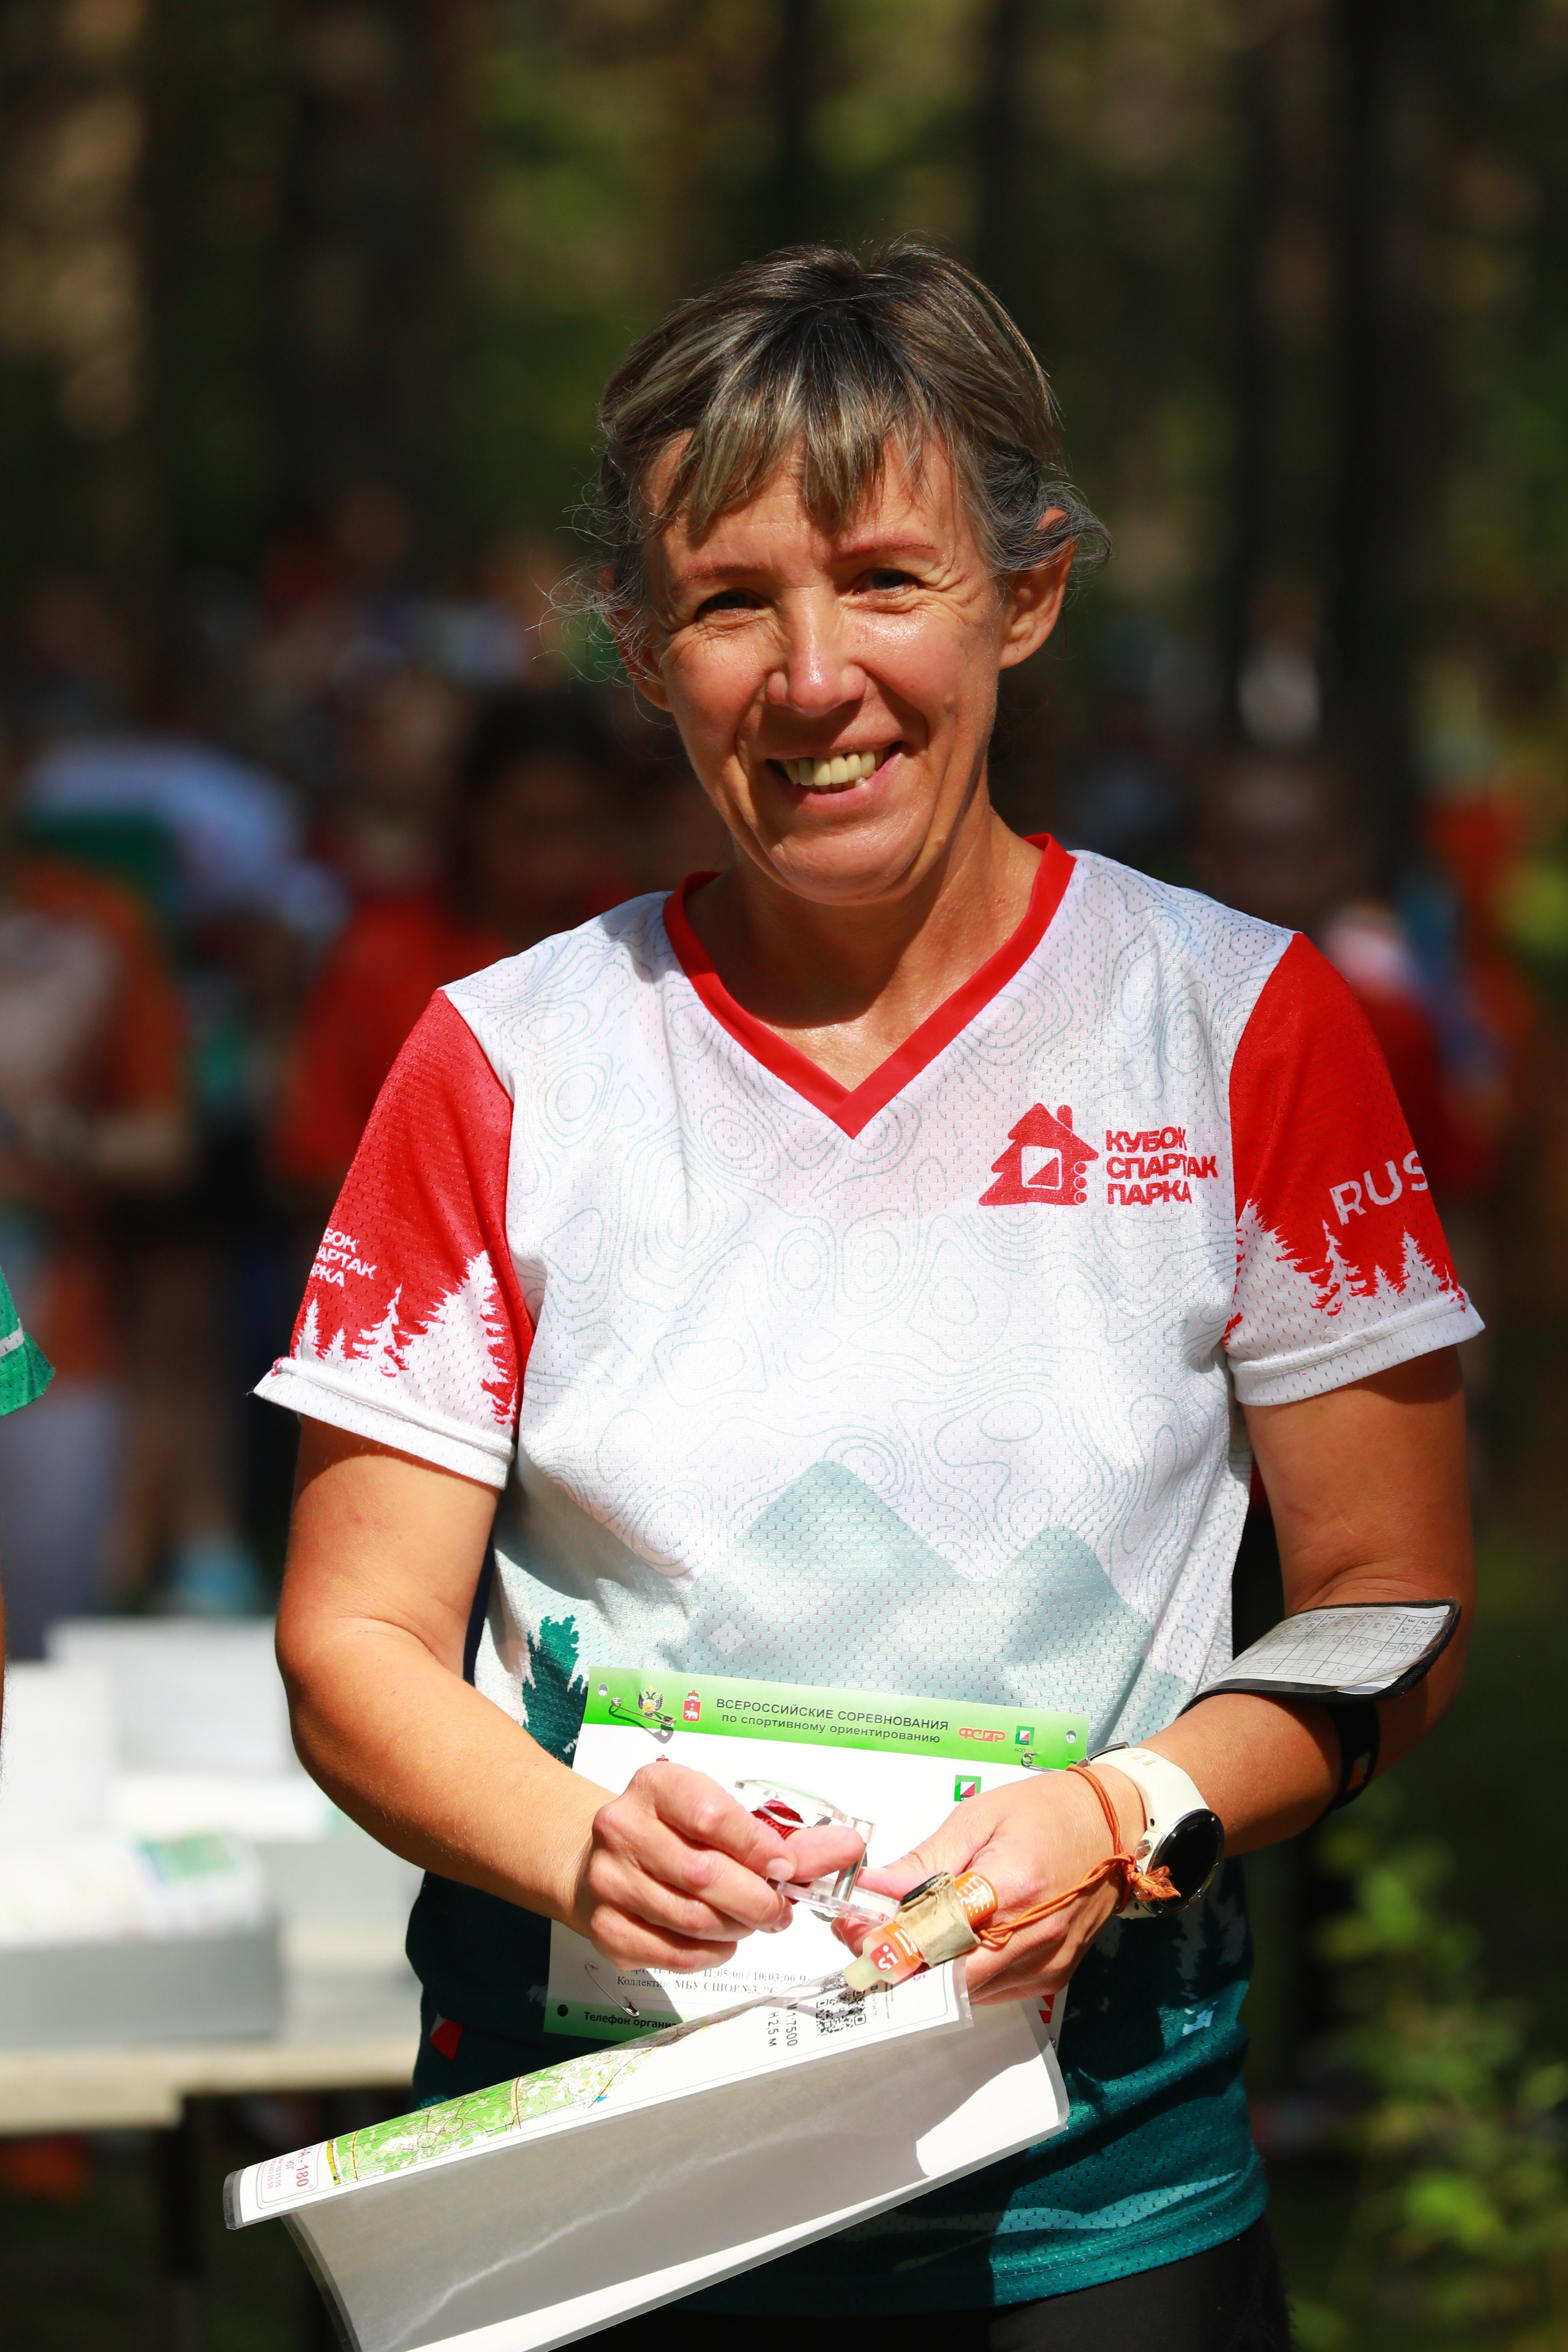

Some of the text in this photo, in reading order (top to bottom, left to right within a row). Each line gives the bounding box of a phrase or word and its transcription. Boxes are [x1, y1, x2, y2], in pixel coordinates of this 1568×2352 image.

[1106, 1126, 1187, 1153] КУБОК
[1106, 1153, 1218, 1179] СПАРТАК
[1107, 1180, 1193, 1205] ПАРКА
[1329, 1150, 1428, 1226] RUS
[716, 1698, 949, 1731] ВСЕРОССИЙСКИЕ СОРЕВНОВАНИЯ
[722, 1714, 940, 1743] по спортивному ориентированию
[617, 1976, 671, 1988] Коллектив:
[674, 1980, 700, 1990] МБУ
[753, 1972, 795, 1983] 10:03:00
[584, 2011, 630, 2026] Телефон
[786, 2013, 798, 2046] 1:7500
